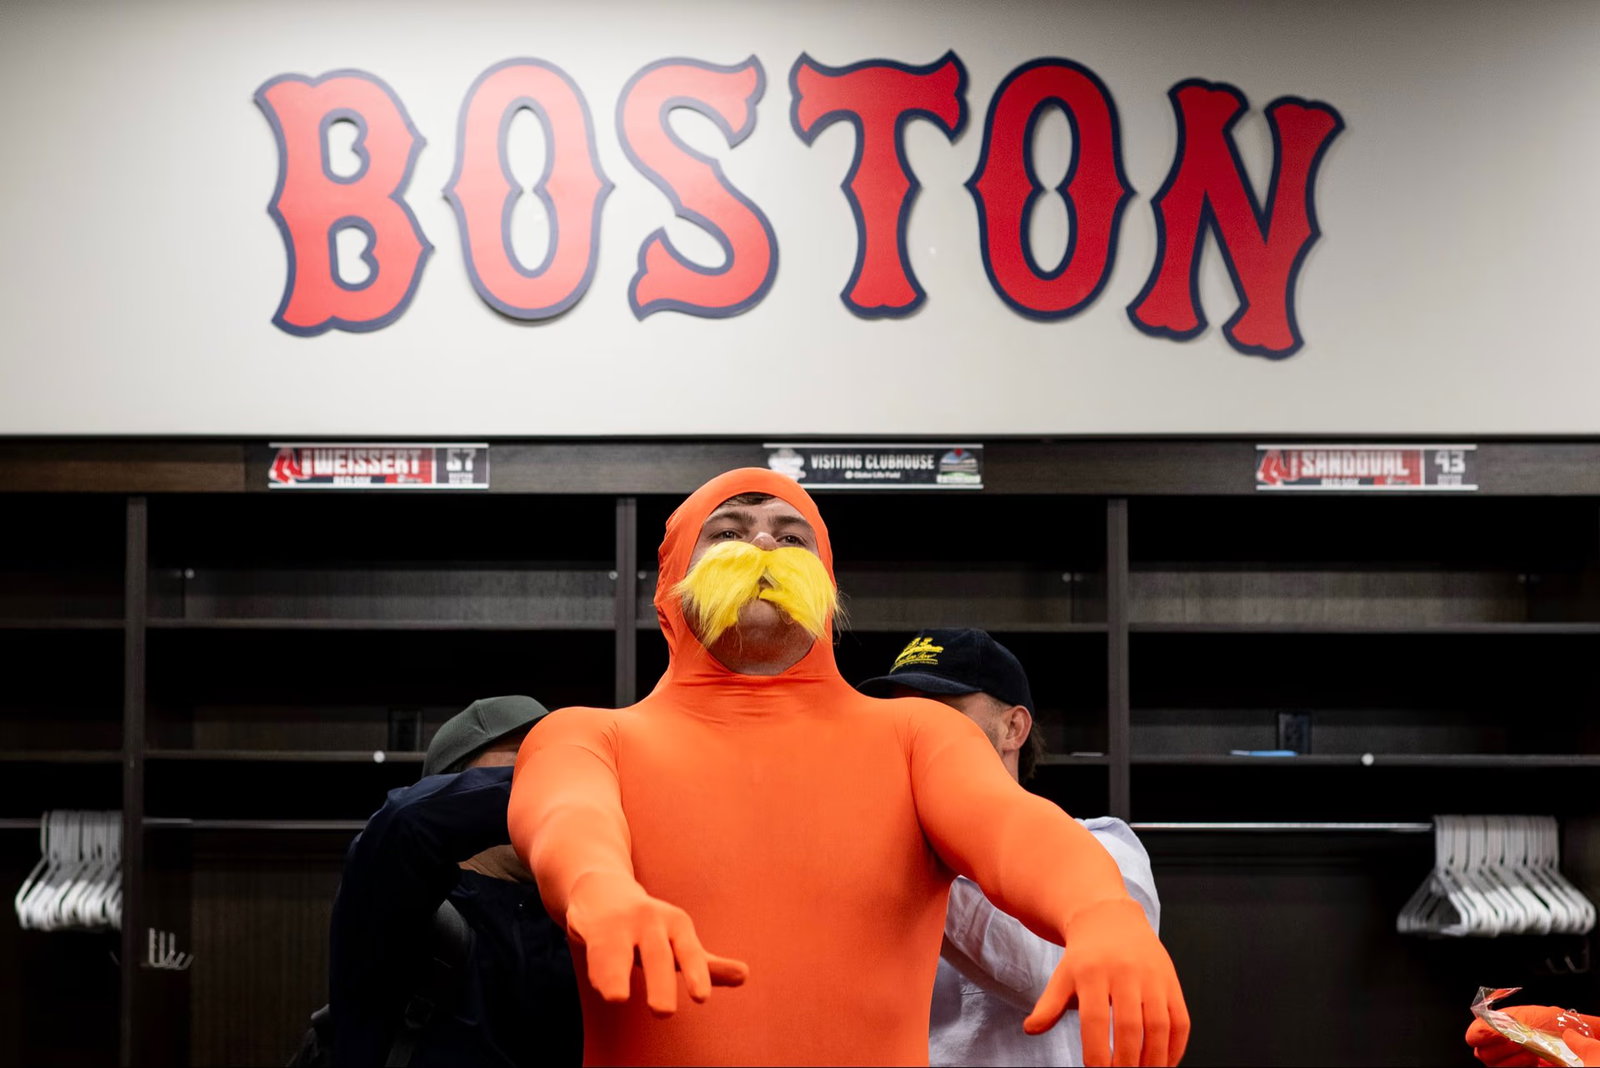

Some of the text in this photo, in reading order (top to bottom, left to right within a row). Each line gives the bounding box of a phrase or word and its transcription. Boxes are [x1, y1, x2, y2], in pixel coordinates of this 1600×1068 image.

[253, 49, 1346, 360] BOSTON
[314, 448, 422, 475] WEISSERT
[446, 448, 476, 472] 57
[811, 455, 935, 470] VISITING CLUBHOUSE
[1301, 450, 1410, 476] SANDOVAL
[1434, 450, 1466, 473] 43
